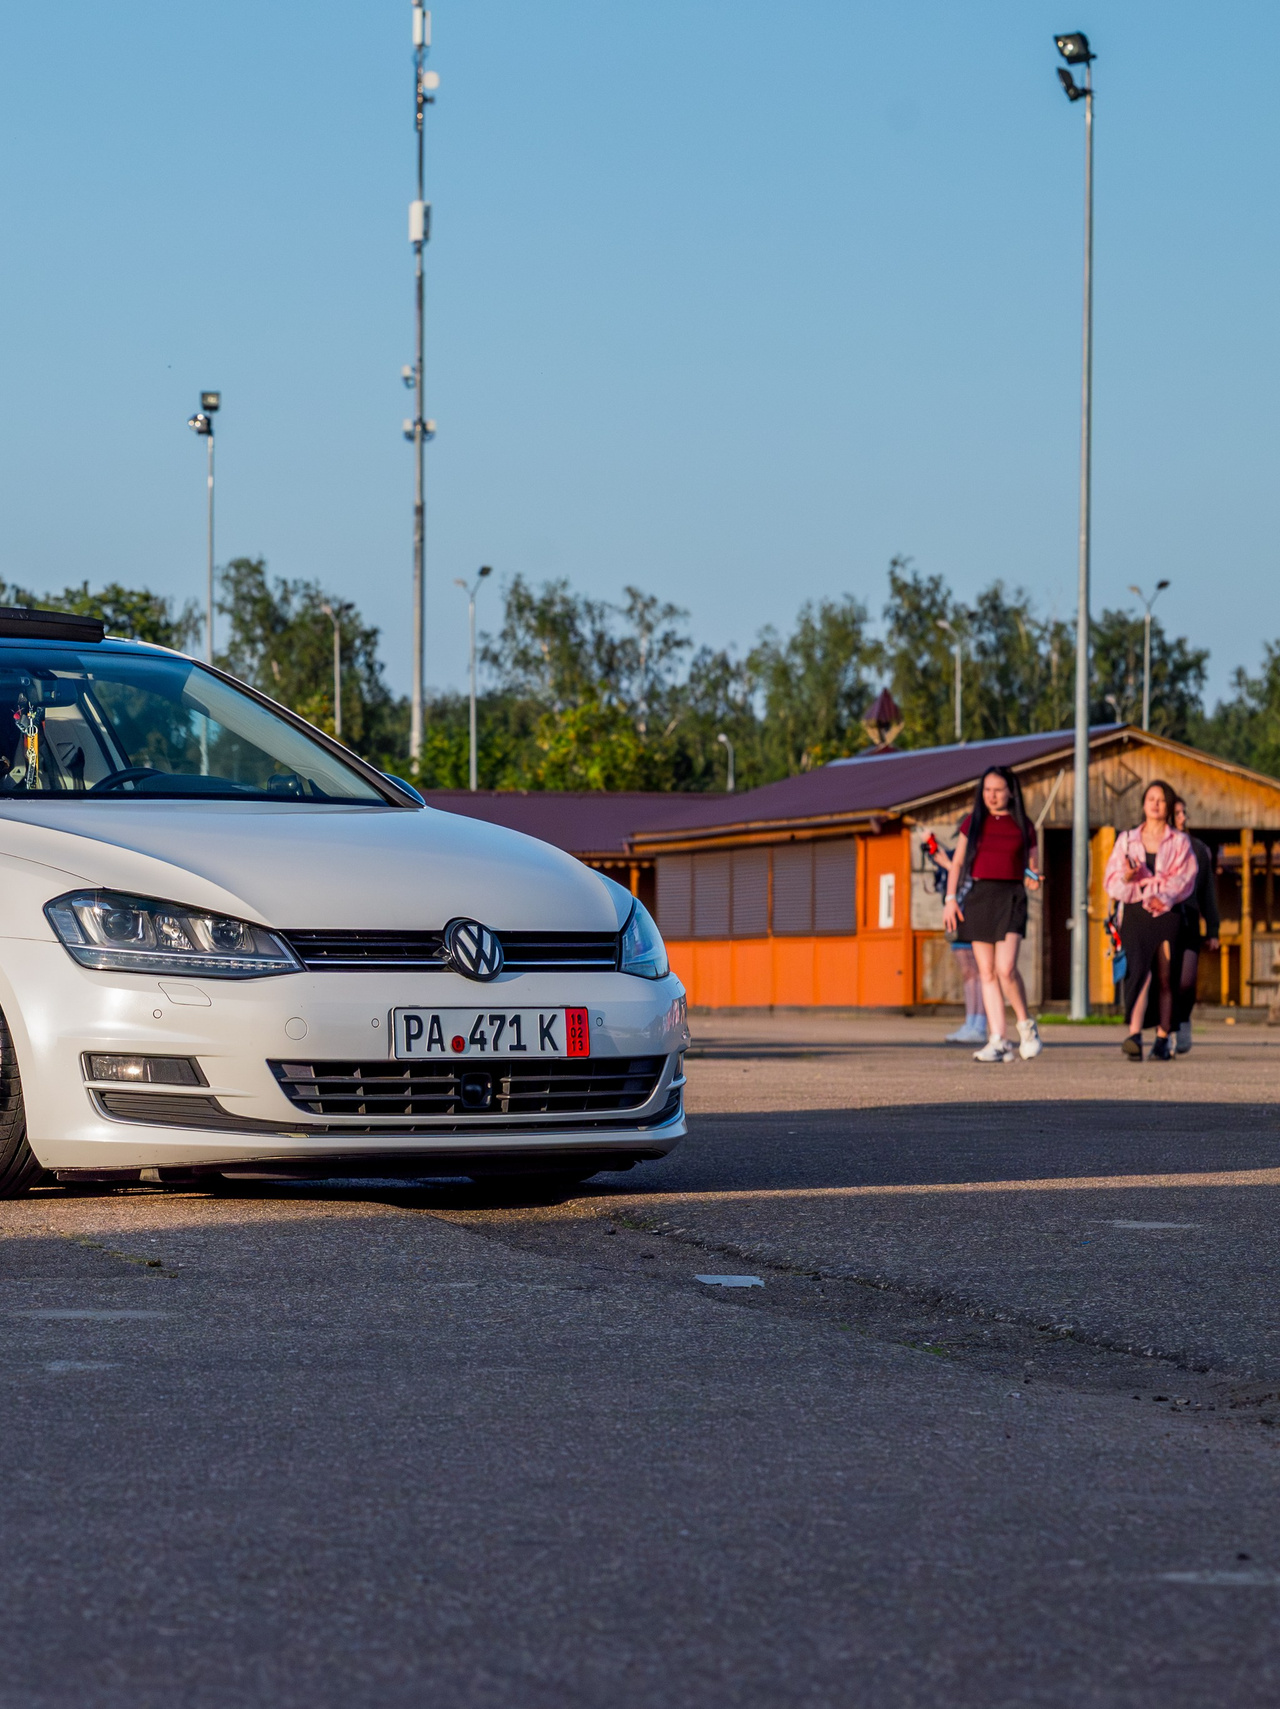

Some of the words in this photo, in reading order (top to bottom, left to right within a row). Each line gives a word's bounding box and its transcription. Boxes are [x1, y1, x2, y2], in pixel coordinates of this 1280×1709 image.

[403, 1013, 446, 1052] PA
[469, 1013, 527, 1052] 471
[538, 1013, 559, 1051] K
[571, 1027, 583, 1038] 02
[572, 1040, 583, 1051] 13
